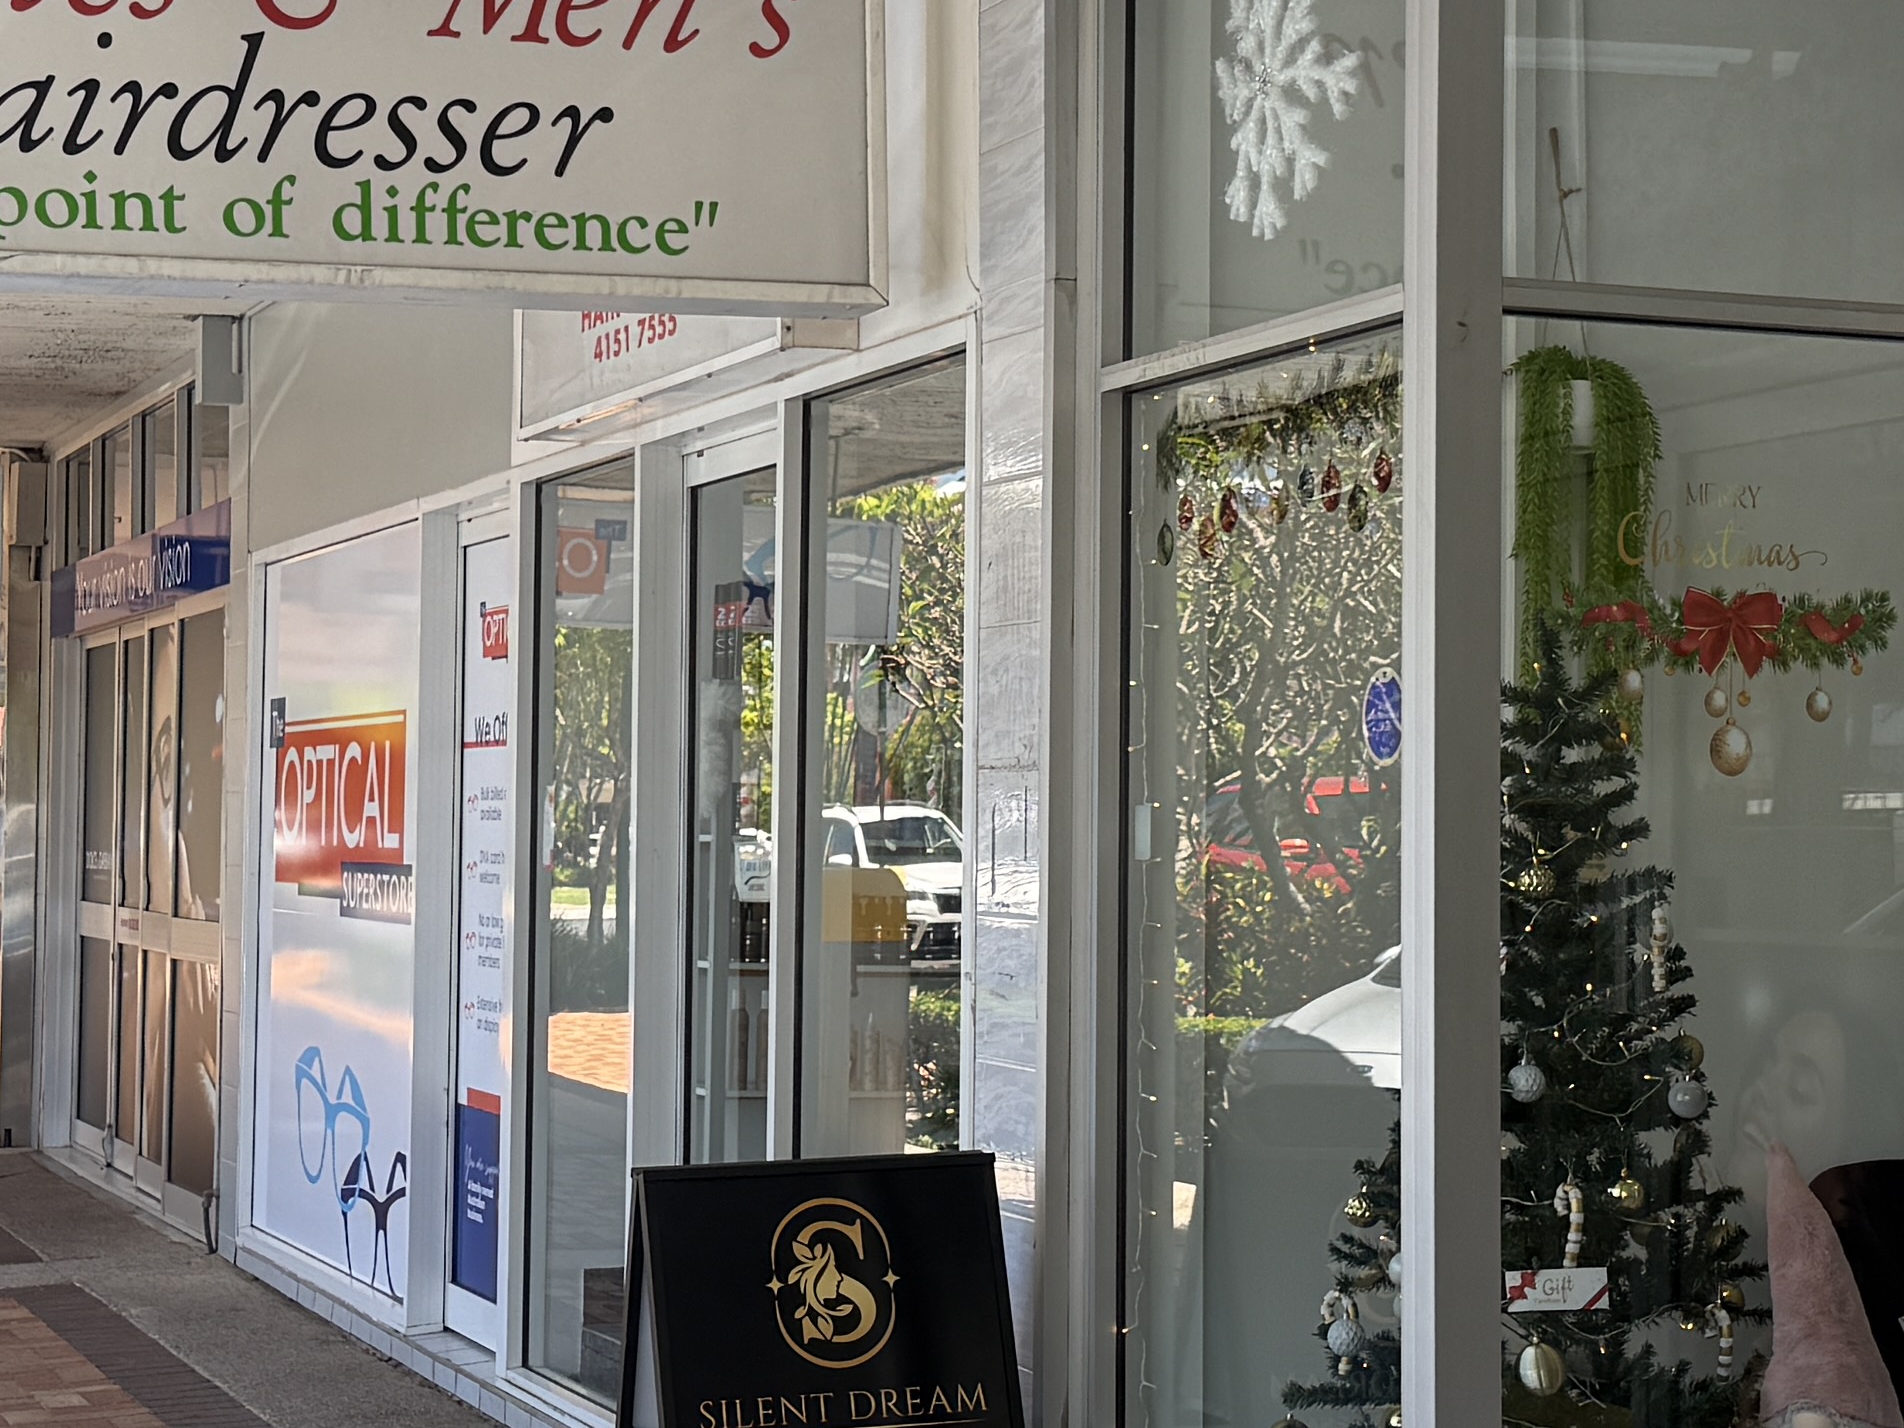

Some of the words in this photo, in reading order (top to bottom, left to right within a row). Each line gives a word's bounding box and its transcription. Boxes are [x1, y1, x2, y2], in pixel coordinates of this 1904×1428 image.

[219, 173, 298, 242] of
[331, 178, 723, 260] difference"
[594, 324, 630, 363] 4151
[637, 312, 678, 349] 7555
[1686, 482, 1764, 509] MERRY
[1617, 509, 1828, 571] Christmas
[138, 554, 157, 596] our
[157, 534, 191, 591] vision
[483, 612, 509, 647] OPTI
[475, 717, 491, 746] We
[280, 739, 400, 849] OPTICAL
[343, 871, 414, 914] SUPERSTORE
[1542, 1274, 1574, 1304] Gift
[850, 1381, 989, 1422] DREAM
